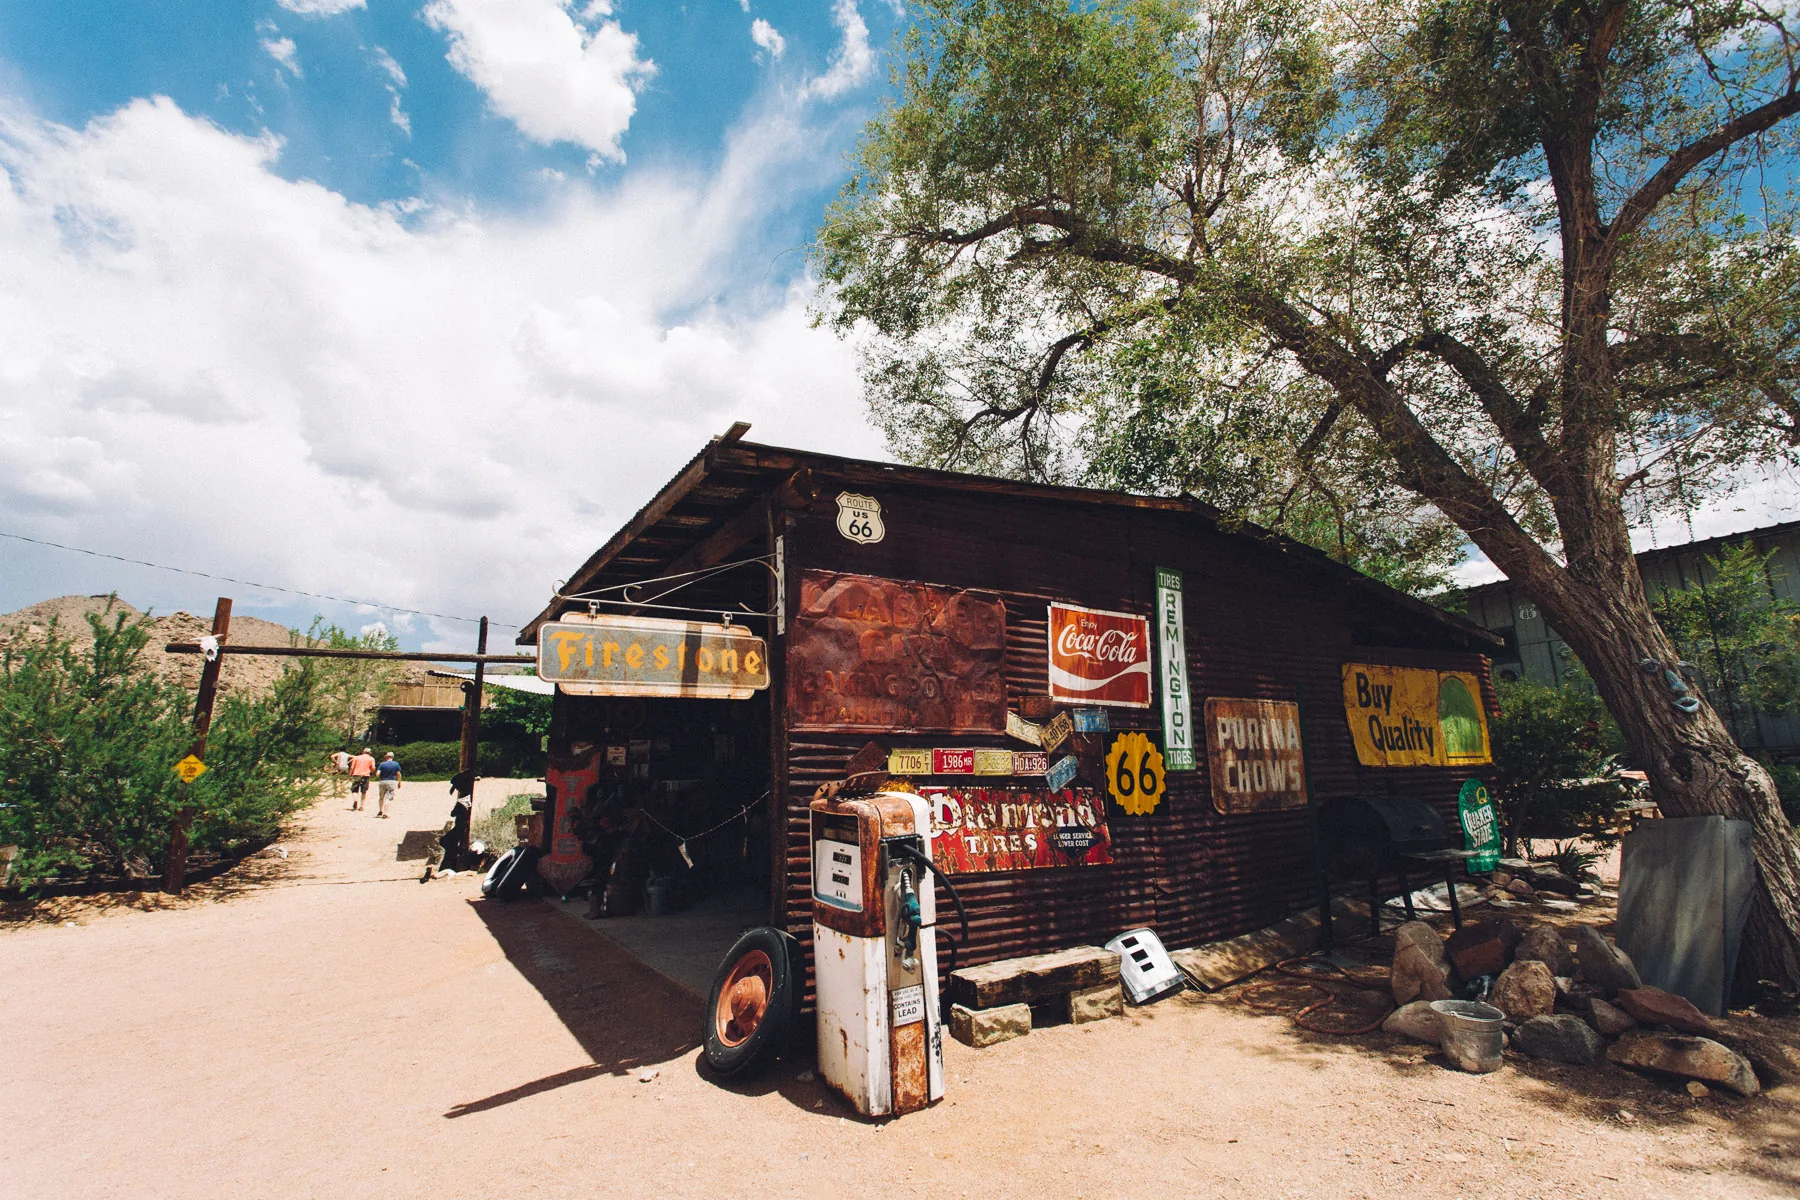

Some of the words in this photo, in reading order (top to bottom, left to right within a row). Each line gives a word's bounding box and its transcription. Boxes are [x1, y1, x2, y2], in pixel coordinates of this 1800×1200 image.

[846, 497, 873, 510] ROUTE
[852, 510, 869, 519] US
[848, 519, 873, 538] 66
[1159, 571, 1181, 590] TIRES
[1080, 618, 1098, 630] Enjoy
[550, 630, 762, 675] Firestone
[1057, 623, 1140, 663] Coca-Cola
[1165, 593, 1185, 746] REMINGTON
[903, 674, 1001, 702] POER
[1355, 672, 1393, 717] Buy
[1043, 718, 1071, 749] A-40158
[1217, 716, 1301, 750] PURINA
[1368, 712, 1435, 758] Quality
[898, 755, 922, 769] 7706
[942, 754, 964, 769] 1986
[963, 757, 974, 767] MR
[1168, 749, 1193, 765] TIRES
[1116, 750, 1158, 797] 66
[1222, 758, 1302, 794] CHOWS
[930, 791, 1099, 837] Diamond
[1462, 804, 1495, 837] QUAKER
[963, 833, 1038, 855] TIRES
[1053, 832, 1072, 840] LNGER
[1075, 839, 1089, 848] COST
[1472, 822, 1496, 849] STATE
[893, 998, 921, 1010] CONTAINS
[898, 1006, 917, 1018] LEAD
